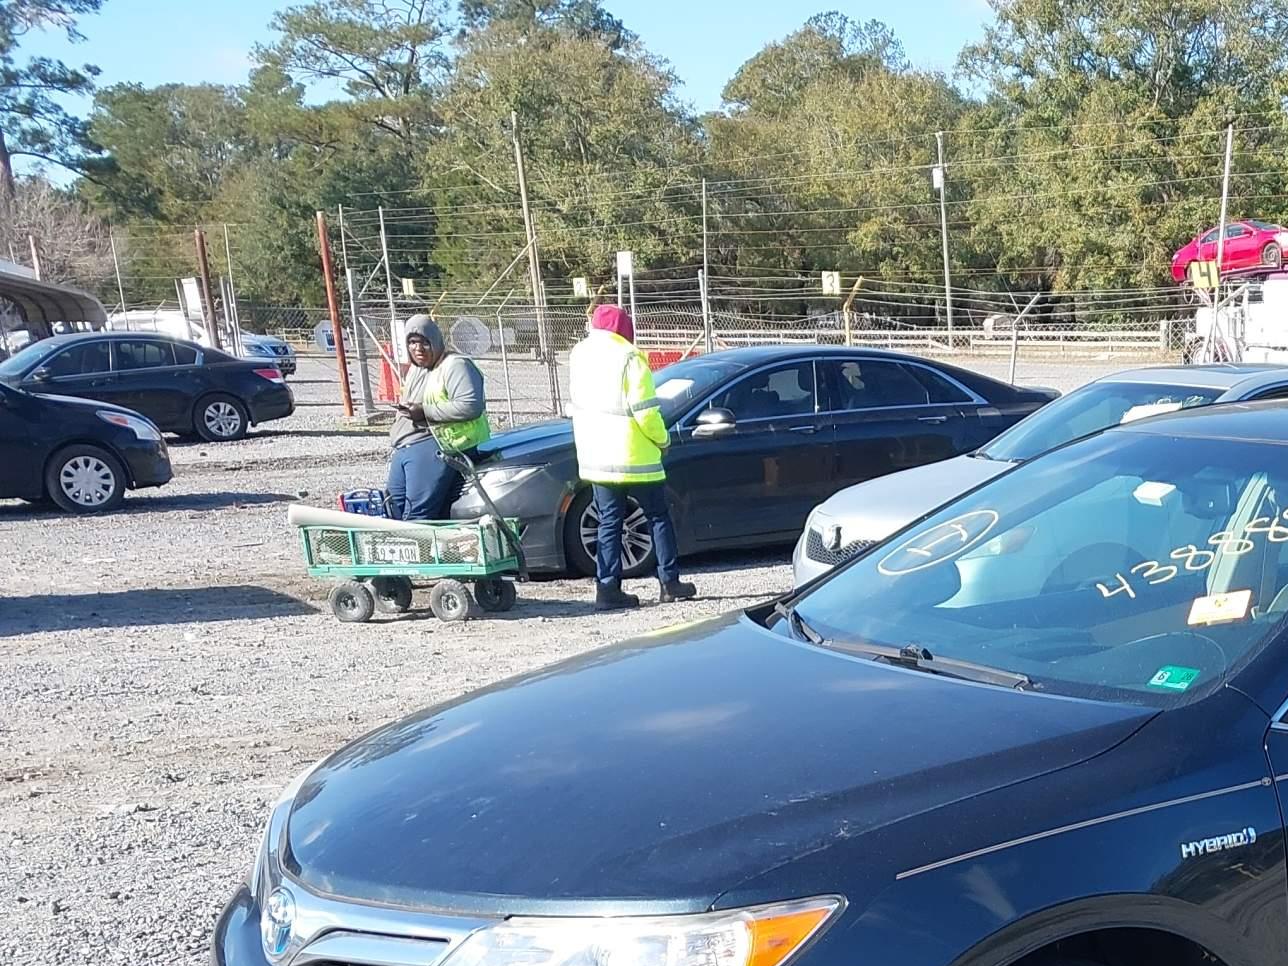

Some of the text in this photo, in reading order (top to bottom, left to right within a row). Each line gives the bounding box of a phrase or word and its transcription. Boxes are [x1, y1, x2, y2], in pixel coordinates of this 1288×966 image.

[826, 273, 836, 294] 3
[1198, 261, 1213, 289] 4
[1181, 831, 1244, 859] HYBRID
